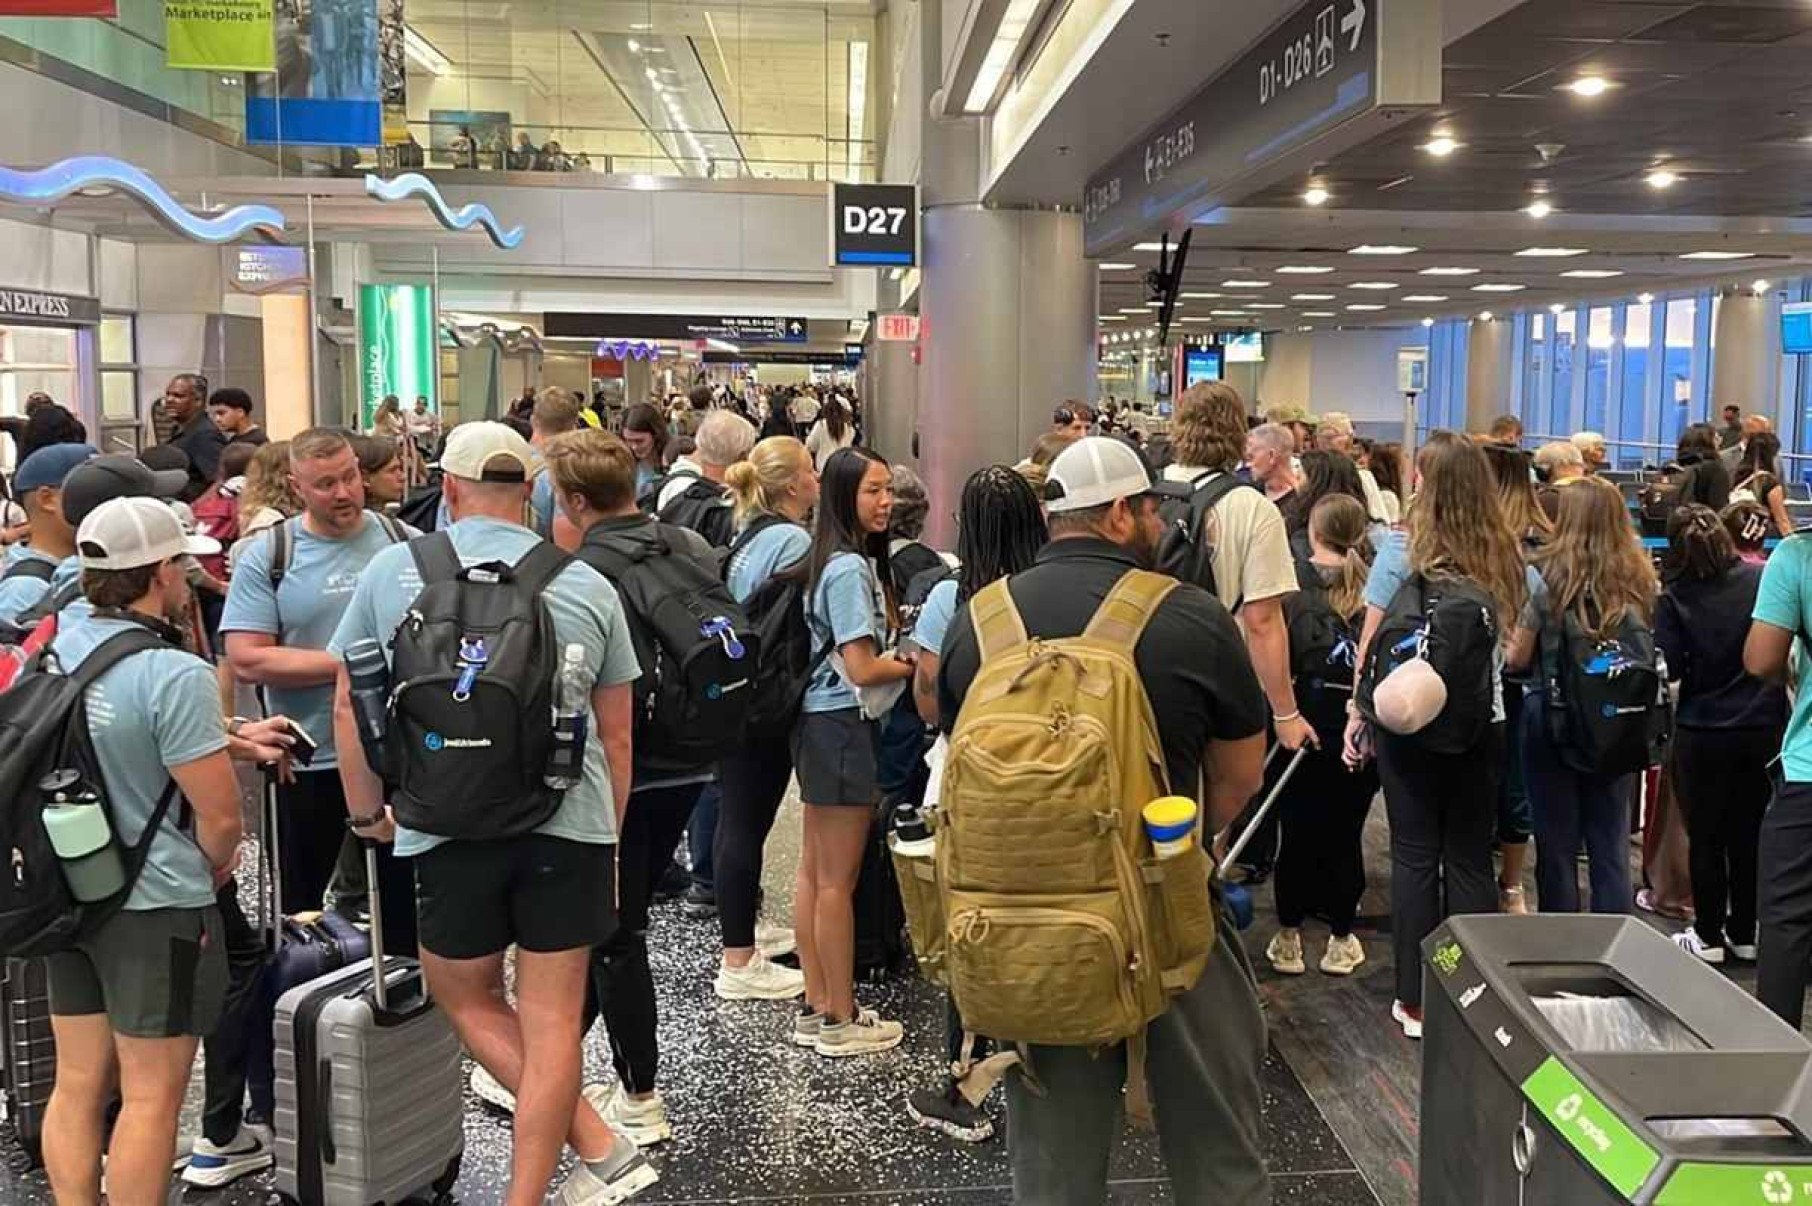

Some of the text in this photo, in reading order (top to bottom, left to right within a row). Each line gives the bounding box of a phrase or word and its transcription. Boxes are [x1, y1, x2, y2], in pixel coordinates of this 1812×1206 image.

[166, 7, 253, 21] Marketplace
[843, 205, 907, 235] D27
[14, 292, 69, 317] EXPRESS
